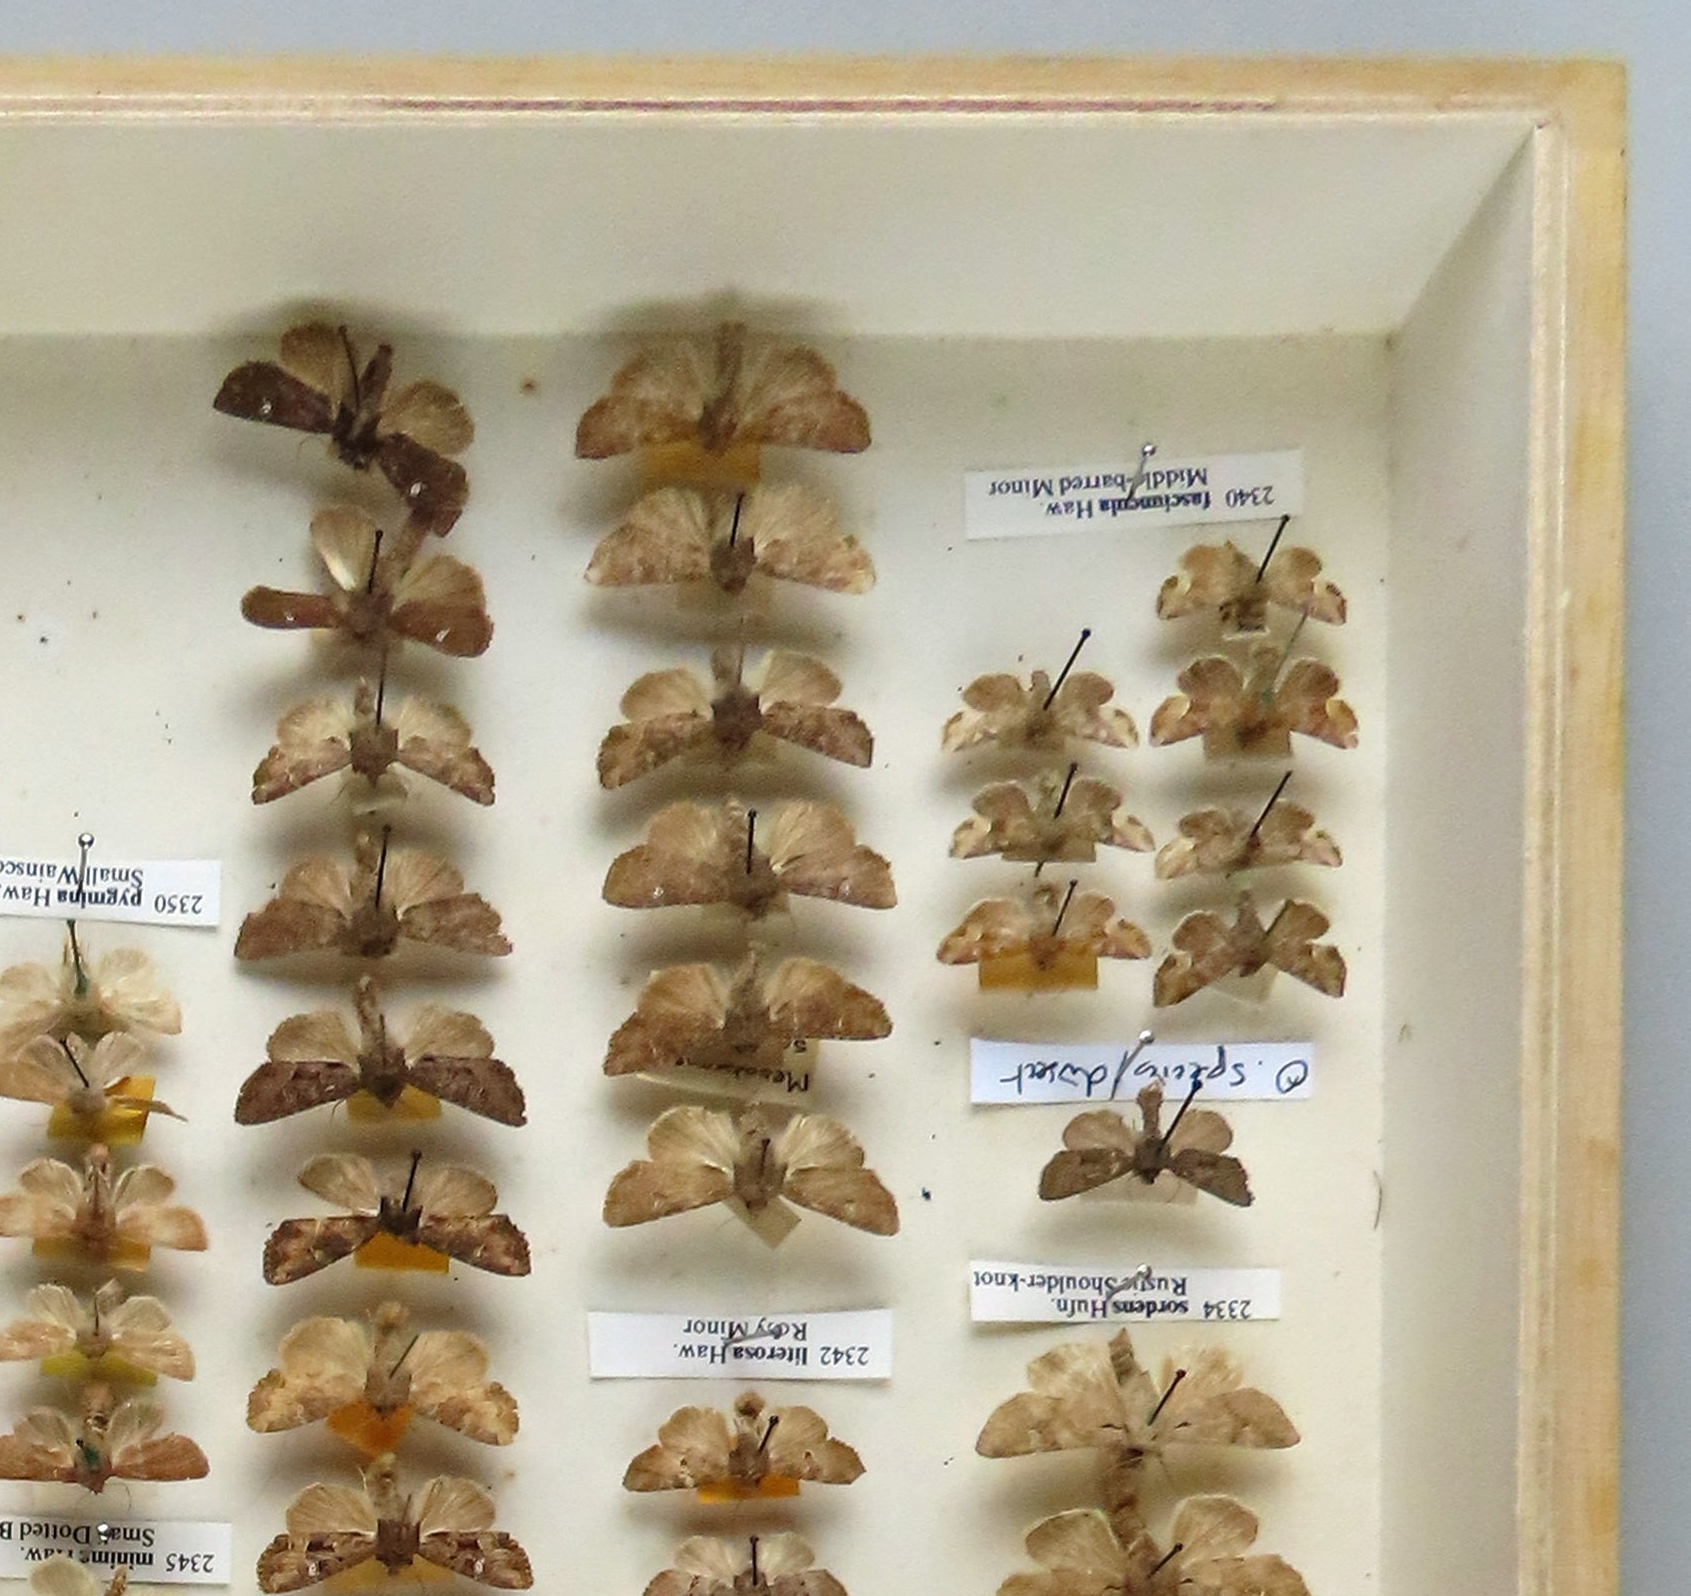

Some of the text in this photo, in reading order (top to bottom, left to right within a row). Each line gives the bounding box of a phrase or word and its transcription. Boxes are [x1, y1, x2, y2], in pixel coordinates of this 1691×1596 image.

[989, 479, 1053, 502] Minor
[1040, 486, 1275, 518] 2340 fasciuncula Haw.
[84, 866, 144, 889] Small
[57, 887, 143, 909] pygmina
[154, 895, 203, 914] 2350
[1051, 1298, 1251, 1319] 2334 sordens Hufn.
[682, 1320, 748, 1340] Minor
[673, 1344, 869, 1365] 2342 literosa Haw.
[19, 1522, 90, 1543] Dotted
[166, 1554, 214, 1573] 2345
